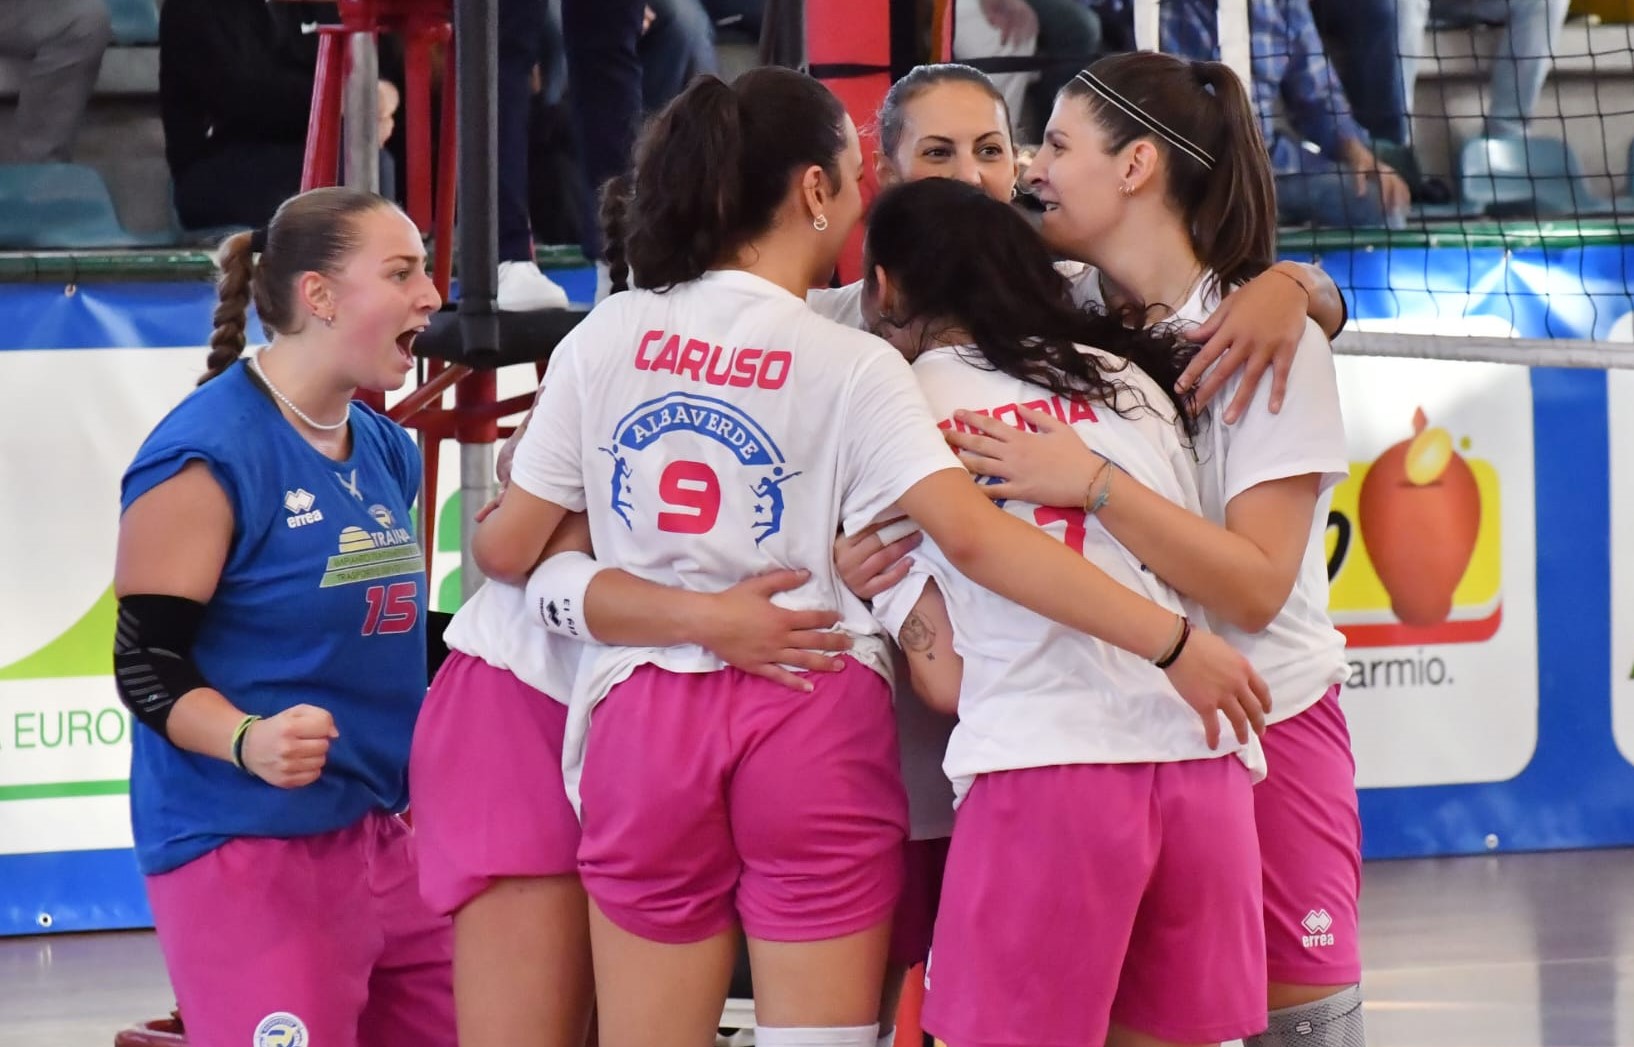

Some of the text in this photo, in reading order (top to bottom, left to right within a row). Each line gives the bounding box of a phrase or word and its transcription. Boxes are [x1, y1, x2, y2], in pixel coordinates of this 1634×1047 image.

[634, 330, 793, 390] CARUSO
[631, 405, 760, 460] ALBAVERDE
[286, 509, 324, 529] errea
[657, 460, 722, 535] 9
[361, 581, 418, 637] 15
[15, 708, 132, 749] EURO
[1301, 933, 1335, 948] errea
